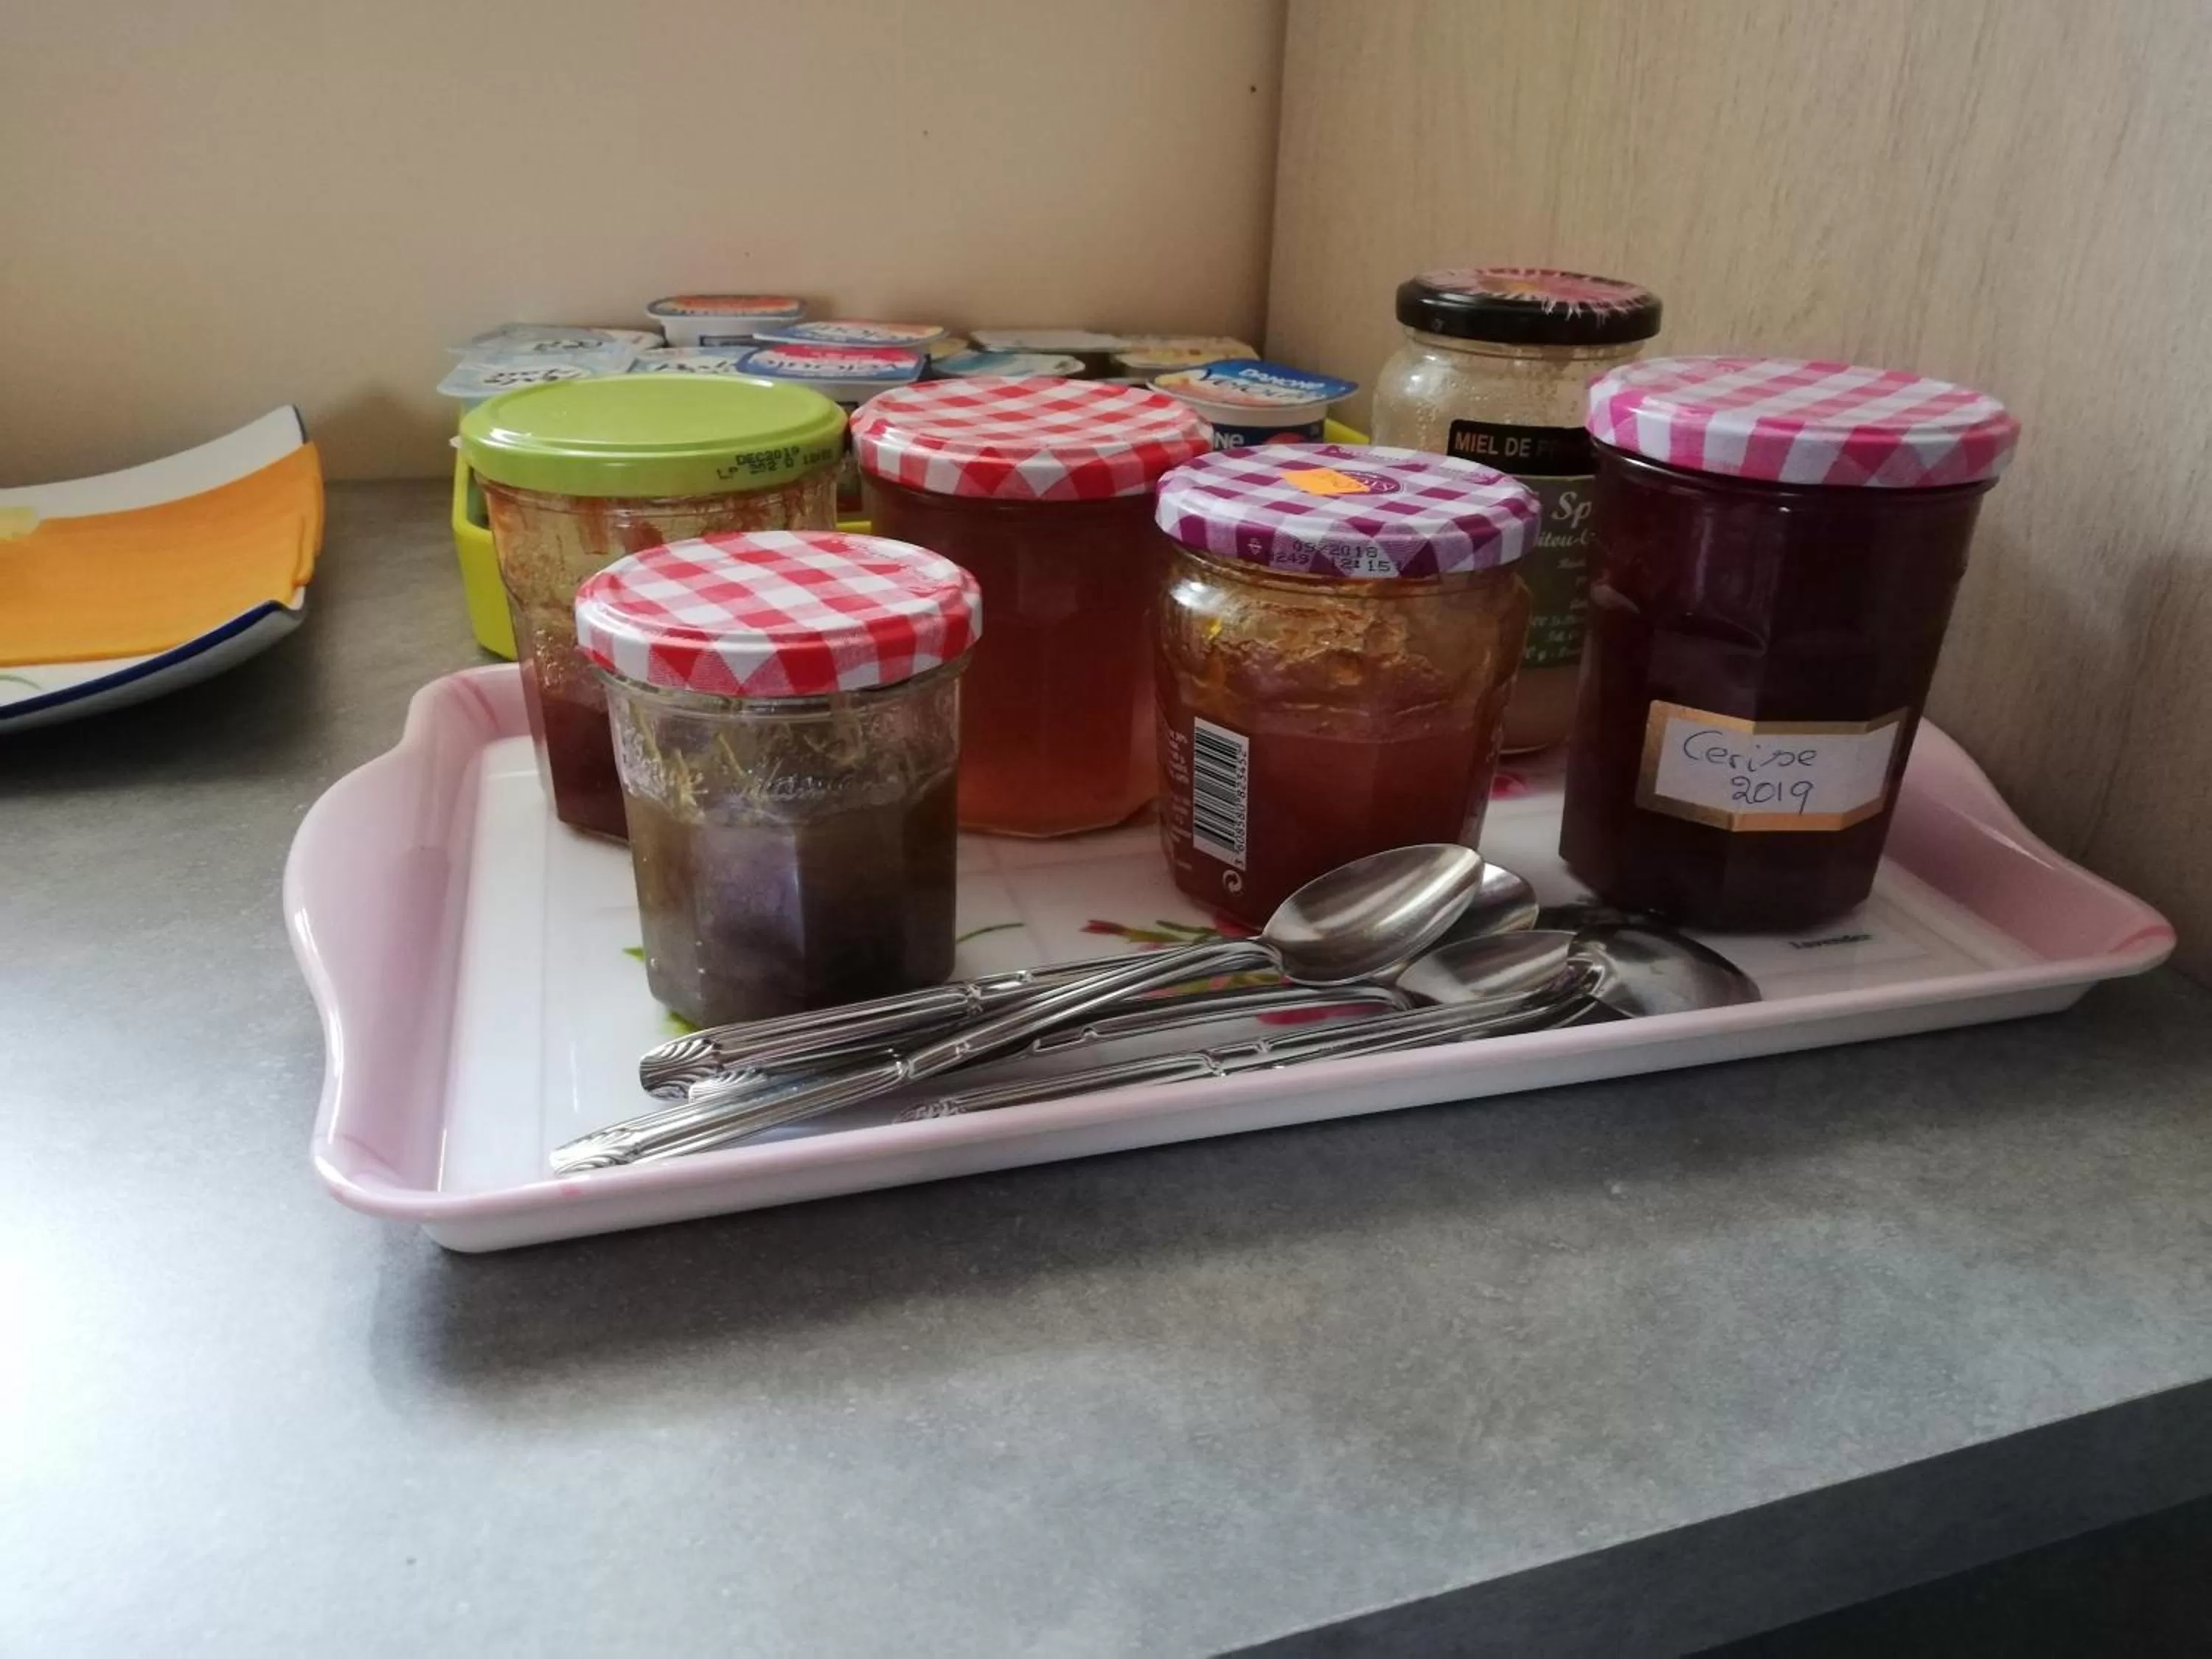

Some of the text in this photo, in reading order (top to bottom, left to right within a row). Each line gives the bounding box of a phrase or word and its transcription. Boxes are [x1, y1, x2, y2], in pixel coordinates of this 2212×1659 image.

[1454, 431, 1499, 455] MIEL
[1504, 437, 1531, 457] DE
[1730, 776, 1815, 815] 2019
